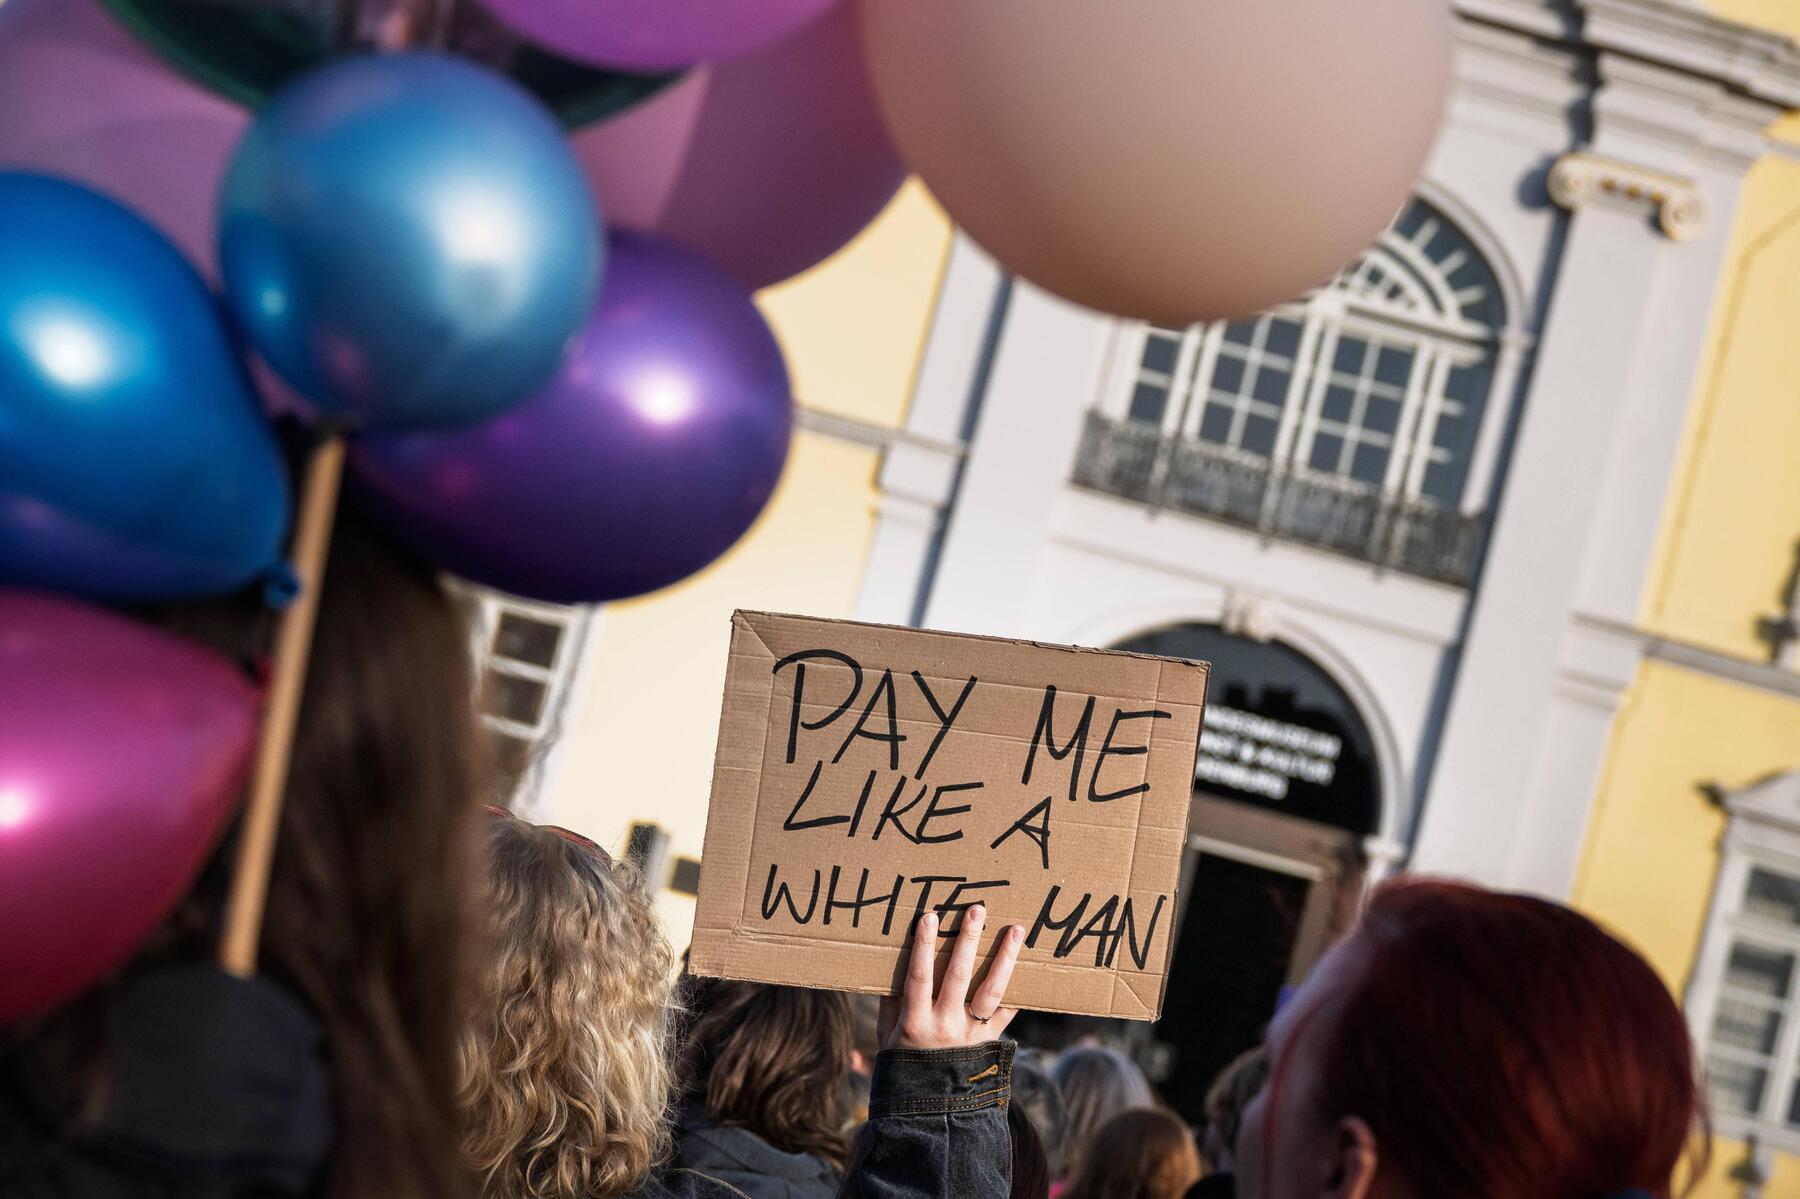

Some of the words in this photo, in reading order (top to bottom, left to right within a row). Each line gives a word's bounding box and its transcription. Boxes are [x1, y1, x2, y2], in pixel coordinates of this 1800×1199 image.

[772, 648, 978, 781] PAY
[1022, 684, 1172, 802] ME
[782, 760, 985, 845] LIKE
[990, 796, 1052, 870] A
[761, 863, 1011, 938] WHITE
[1025, 885, 1167, 971] MAN
